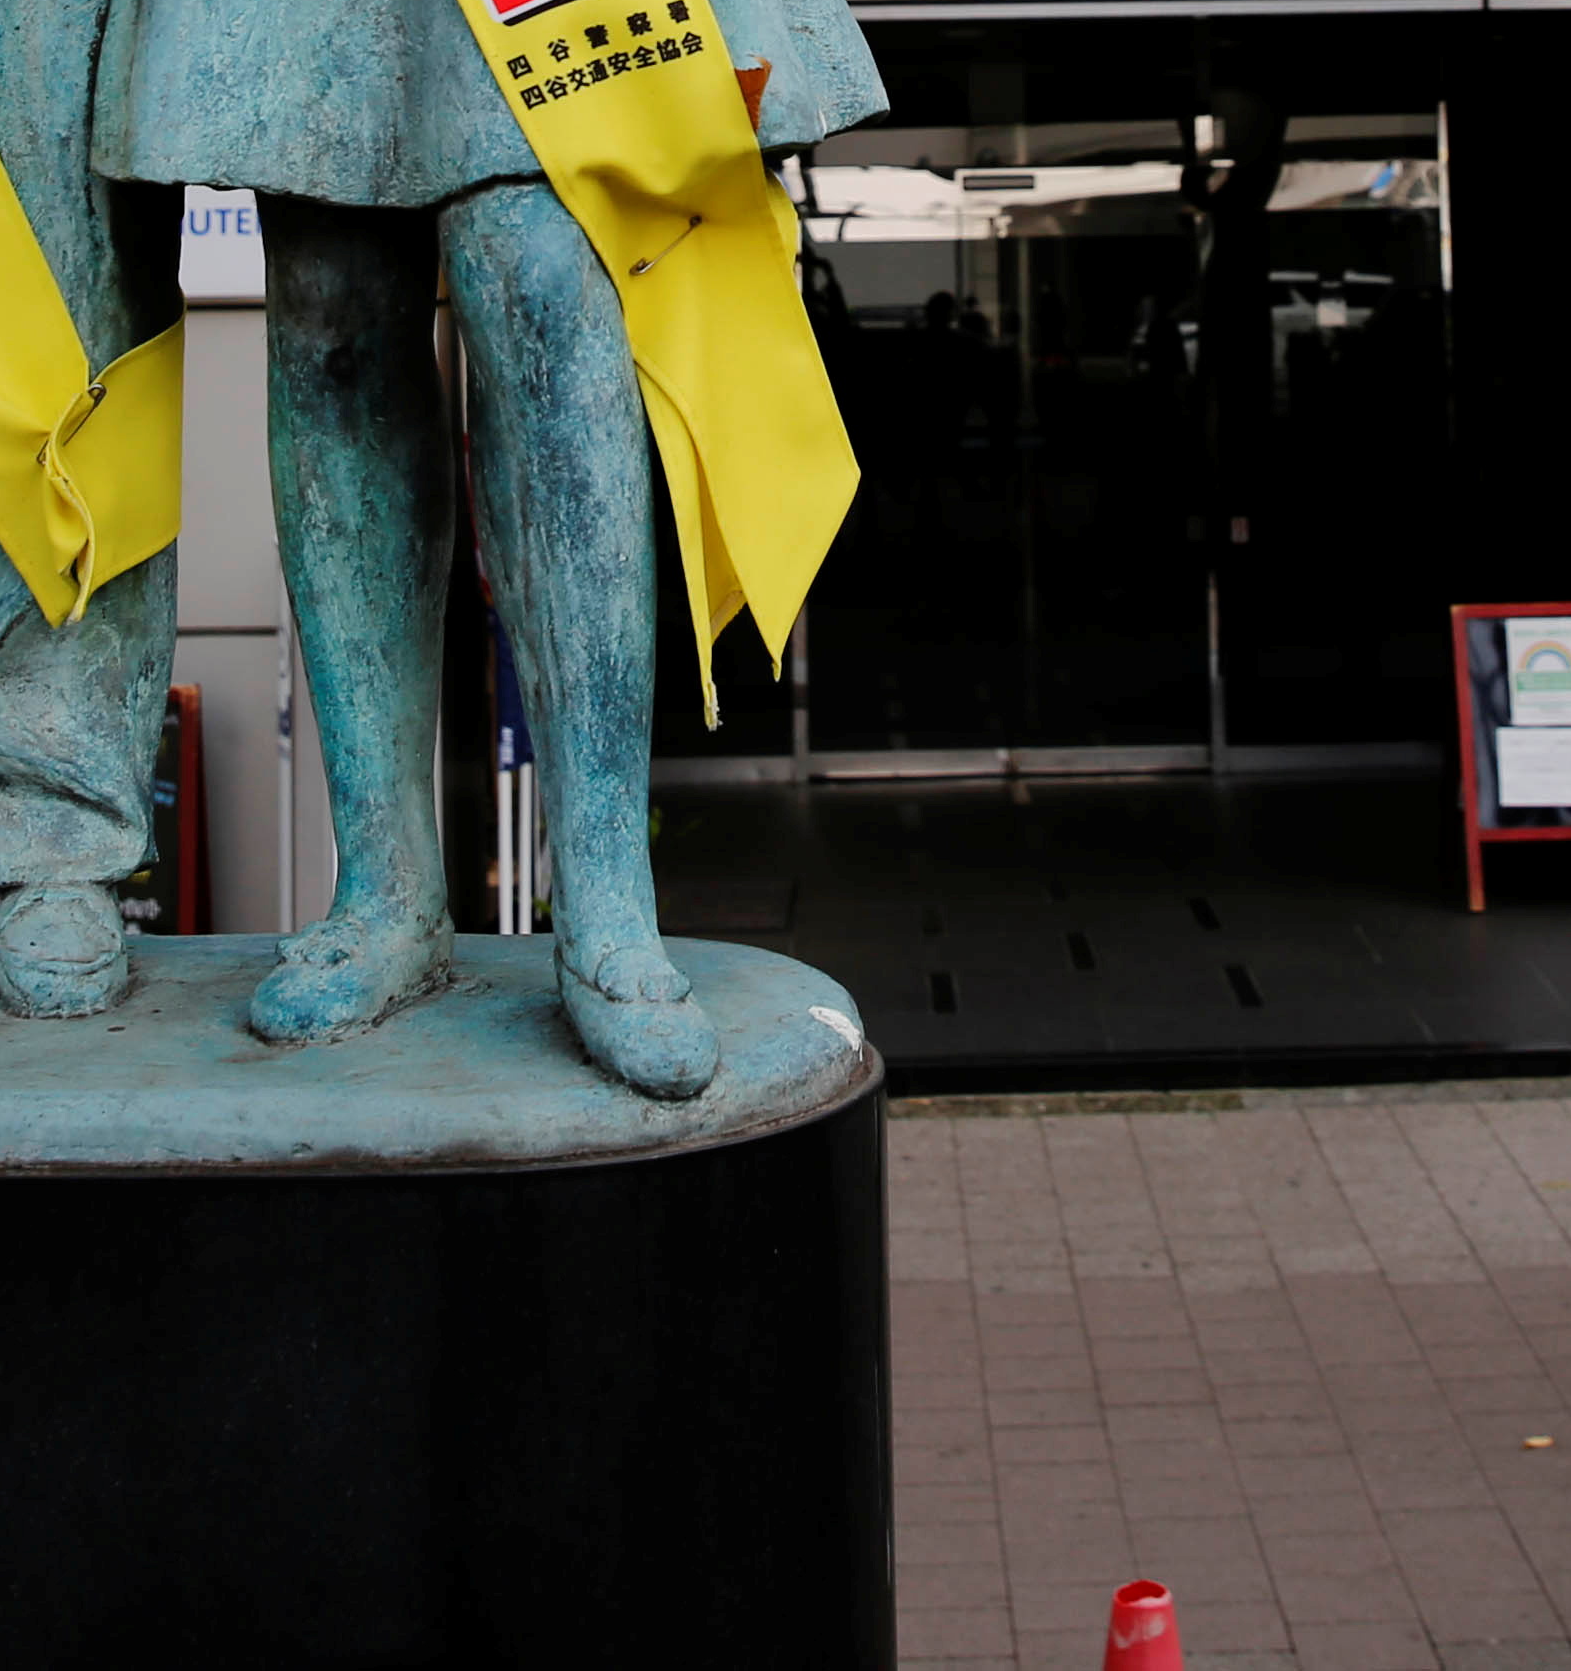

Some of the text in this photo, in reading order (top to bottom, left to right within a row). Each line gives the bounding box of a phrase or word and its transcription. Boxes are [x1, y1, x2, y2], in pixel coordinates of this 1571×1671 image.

[506, 0, 690, 79] 四谷警察署
[519, 31, 704, 110] 四谷交通安全協会
[180, 208, 263, 237] UTE
